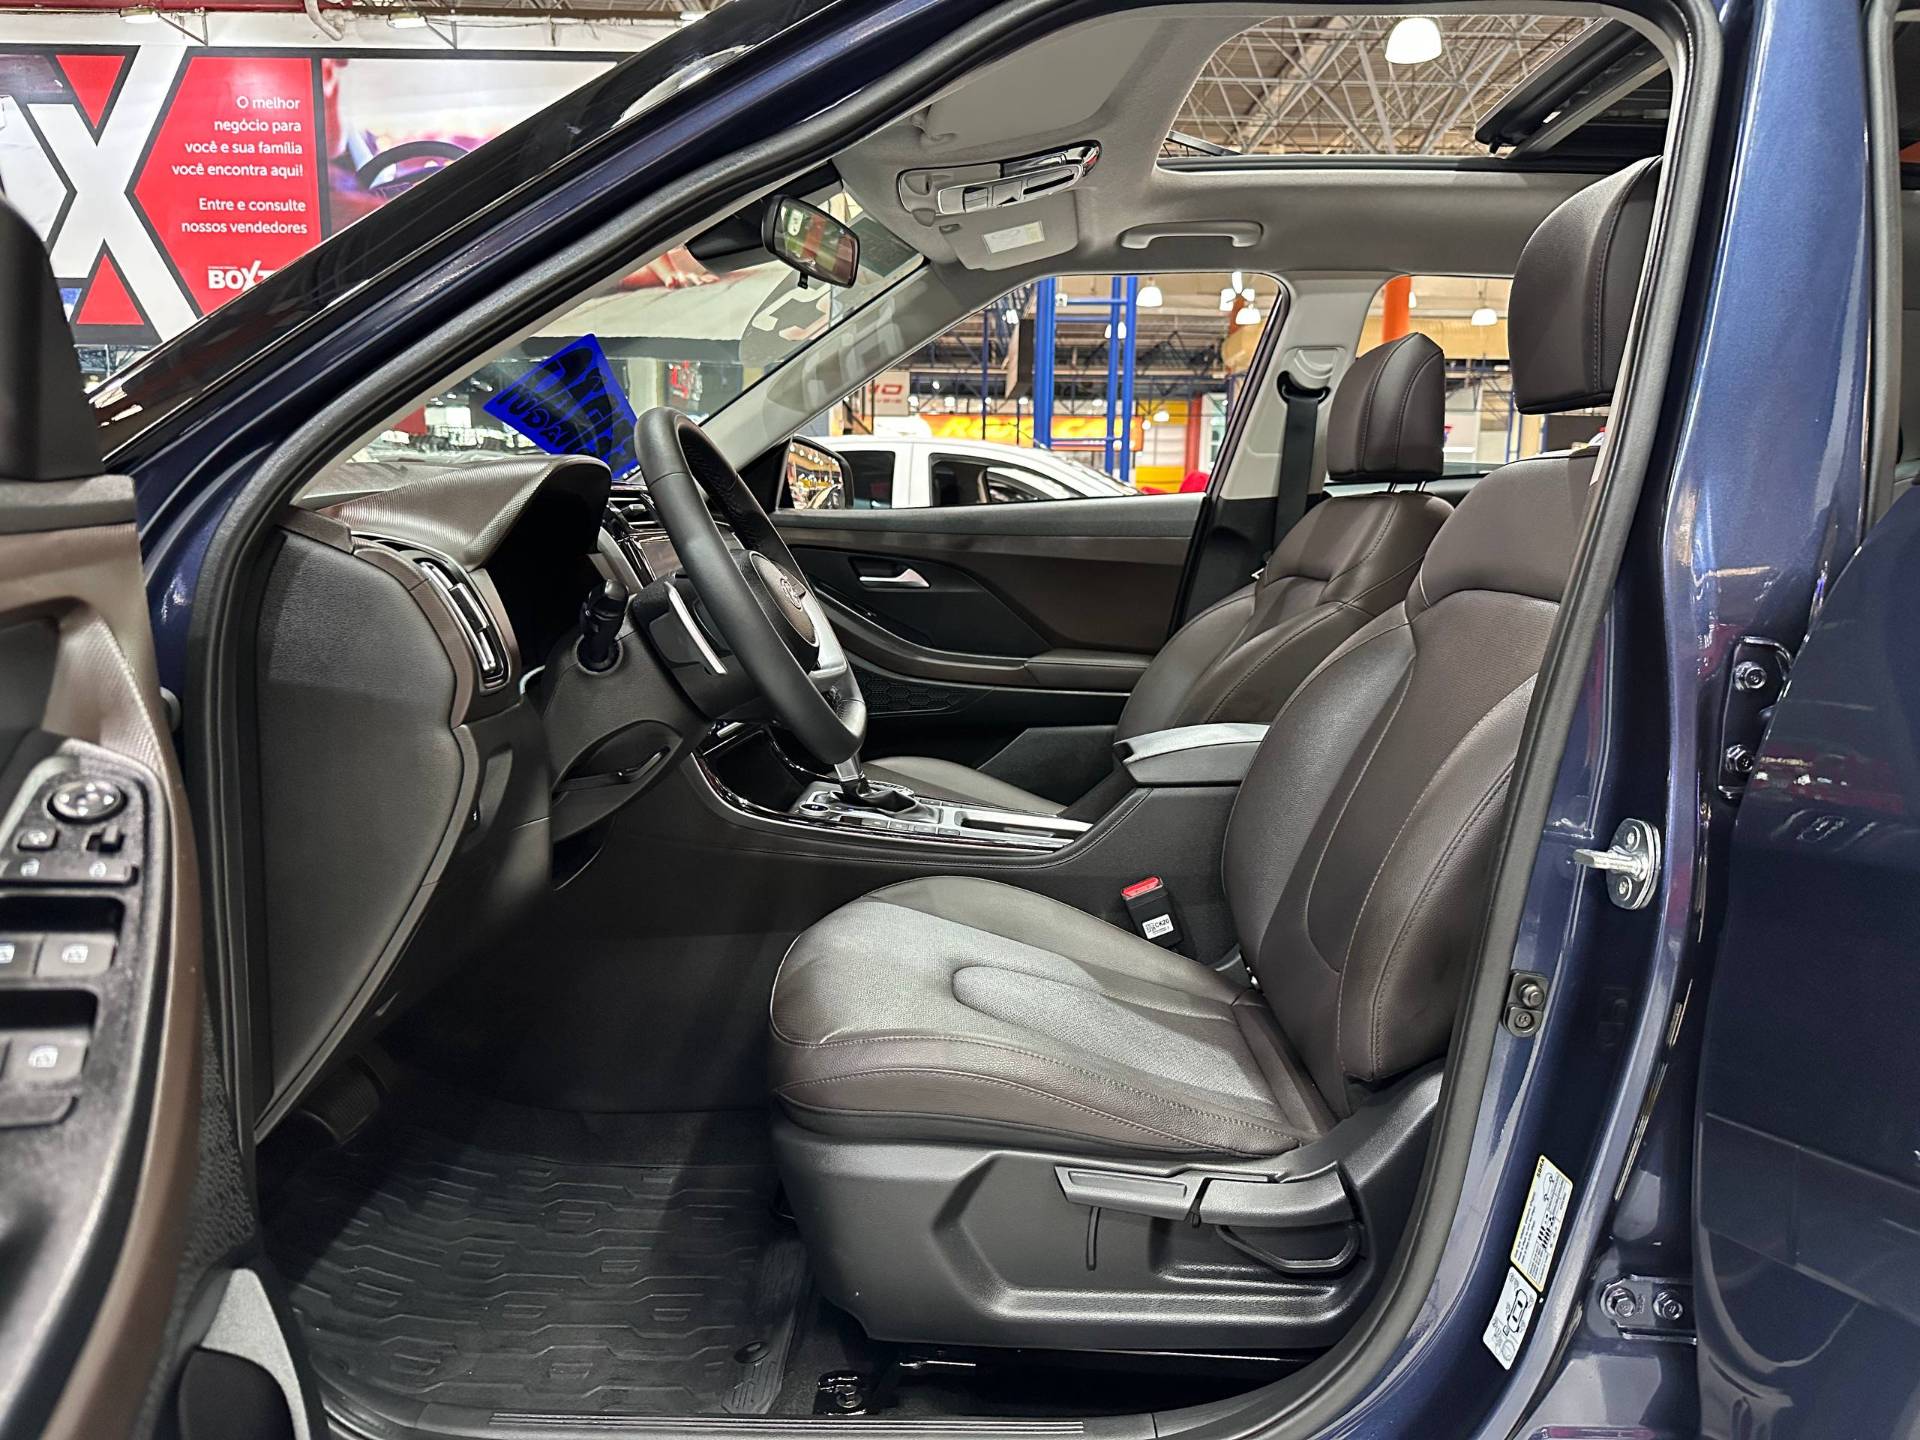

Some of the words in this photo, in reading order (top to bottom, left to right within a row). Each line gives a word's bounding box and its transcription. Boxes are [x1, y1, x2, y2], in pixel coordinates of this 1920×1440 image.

[236, 95, 249, 109] O
[252, 95, 300, 109] melhor
[214, 119, 268, 134] negócio
[272, 121, 302, 134] para
[185, 140, 217, 153] você
[220, 144, 229, 154] e
[232, 144, 255, 154] sua
[258, 141, 303, 155] família
[171, 162, 204, 175] você
[207, 164, 268, 176] encontra
[270, 164, 304, 179] aqui!
[199, 197, 234, 210] Entre
[237, 201, 246, 211] e
[248, 199, 306, 212] consulte
[181, 222, 227, 233] nossos
[229, 221, 308, 234] vendedores
